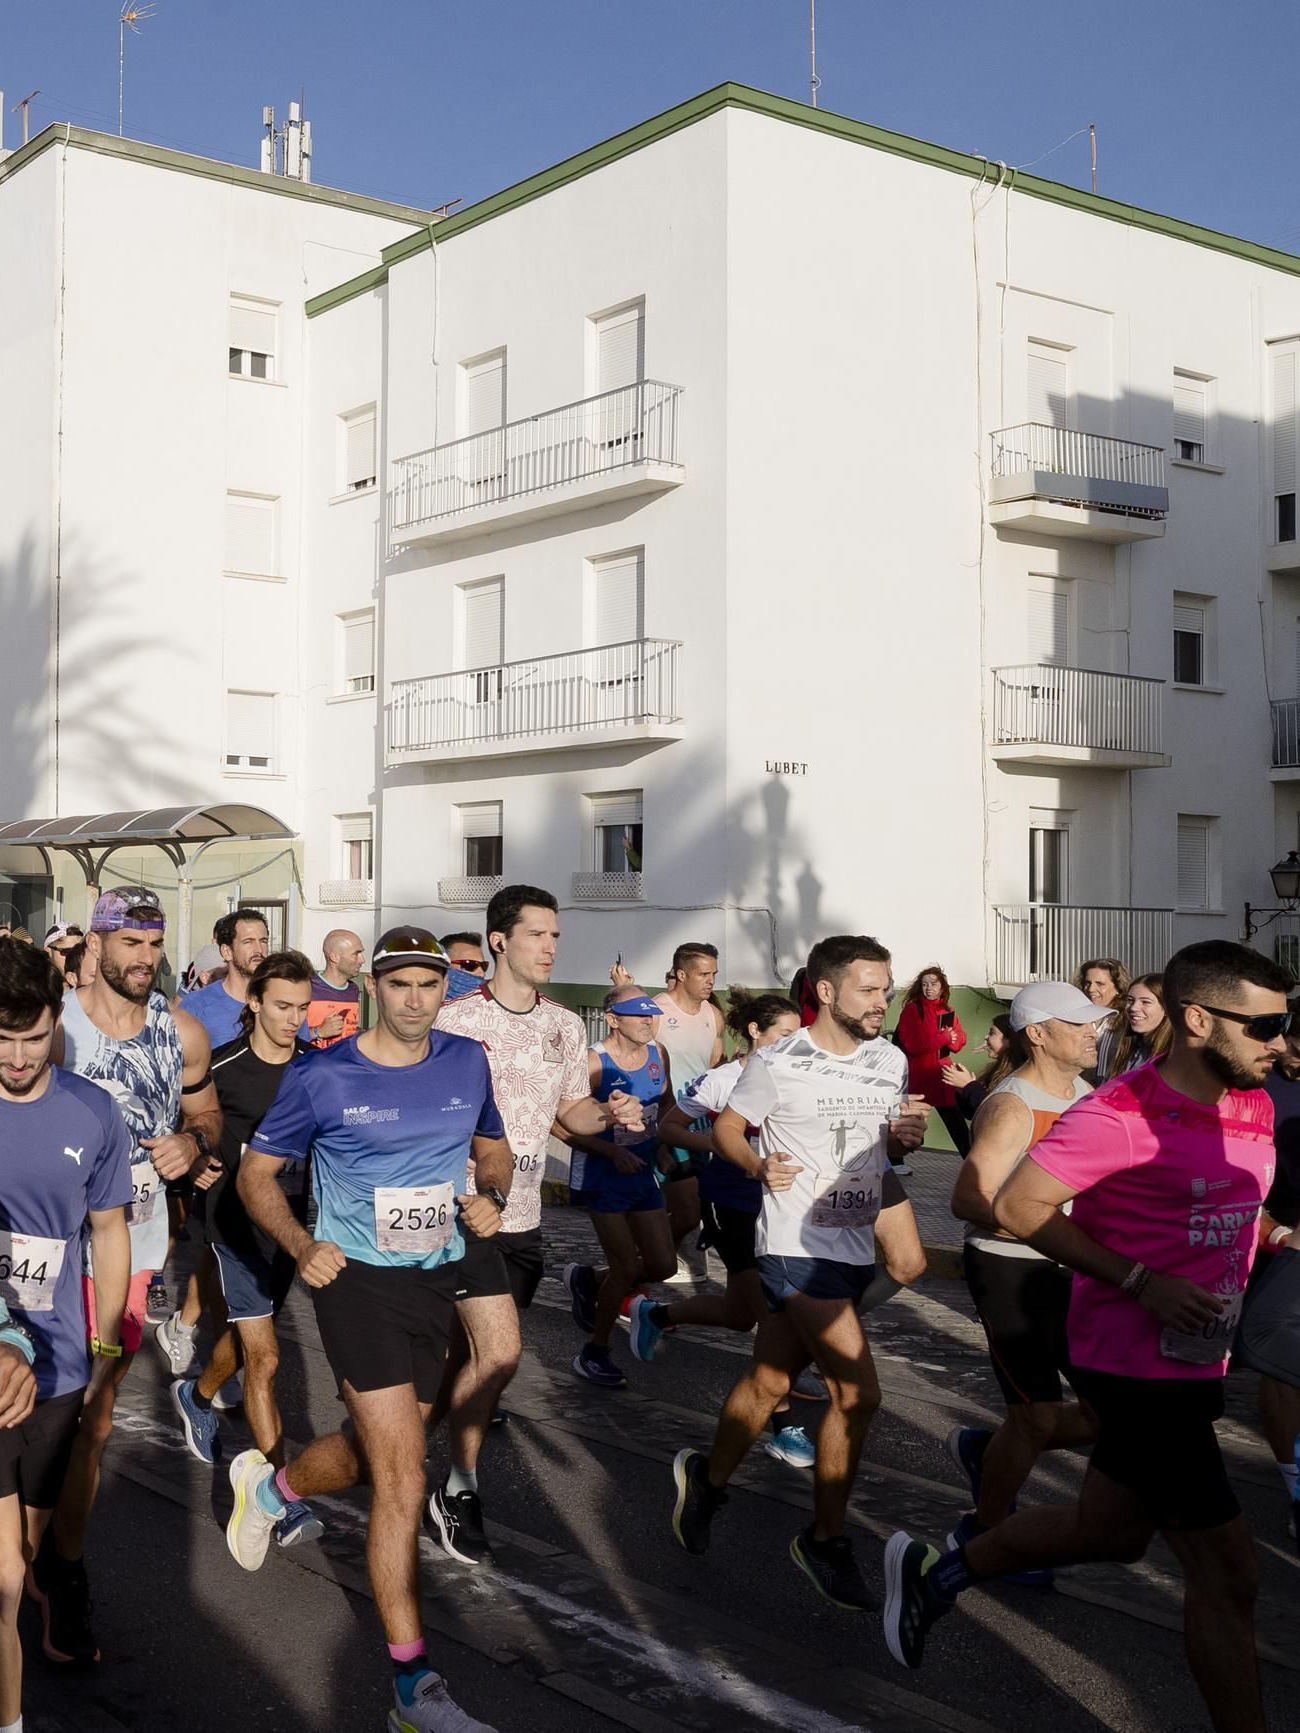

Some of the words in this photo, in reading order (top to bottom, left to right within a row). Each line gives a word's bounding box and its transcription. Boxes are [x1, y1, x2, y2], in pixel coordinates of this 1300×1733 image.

[765, 760, 808, 775] LUBET
[817, 1096, 886, 1106] MEMORIAL
[343, 1108, 399, 1126] INSPIRE
[828, 1188, 874, 1210] 1391
[389, 1203, 447, 1231] 2526
